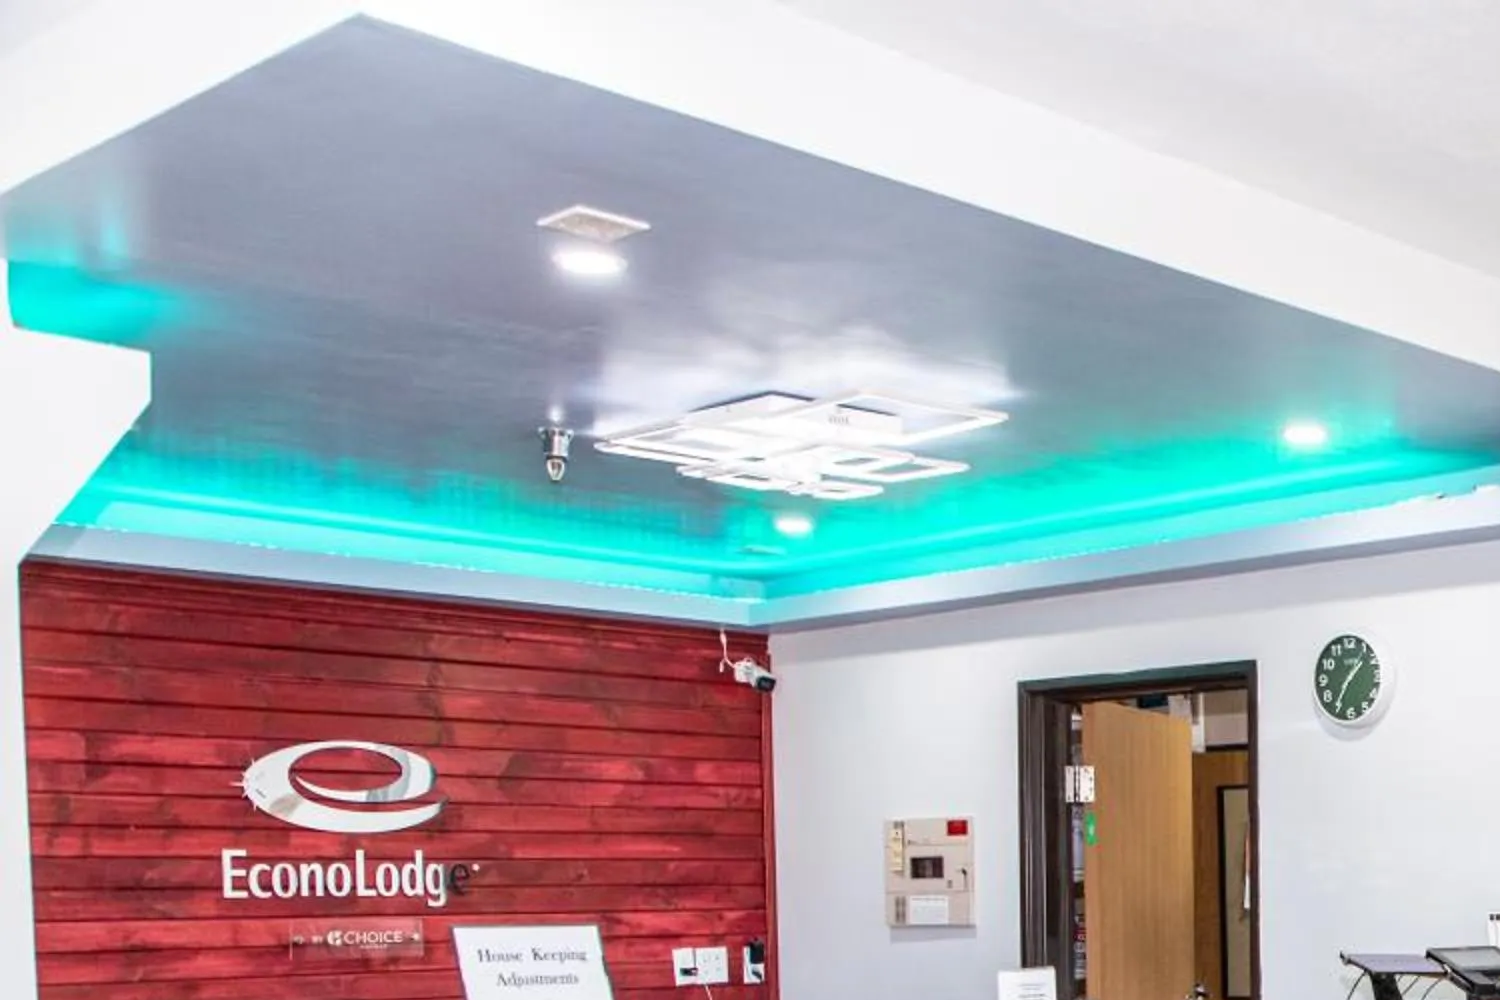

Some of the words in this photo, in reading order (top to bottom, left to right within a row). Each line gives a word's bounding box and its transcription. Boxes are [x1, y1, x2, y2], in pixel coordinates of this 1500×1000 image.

[1343, 638, 1356, 649] 12
[1331, 644, 1341, 656] 11
[1322, 658, 1335, 670] 10
[1318, 674, 1328, 686] 9
[1323, 689, 1332, 702] 8
[1346, 707, 1356, 718] 6
[221, 848, 471, 907] EconoLodge
[343, 930, 403, 945] CHOICE
[477, 948, 524, 963] House
[531, 947, 588, 964] Keeping
[496, 971, 580, 988] Adjustments
